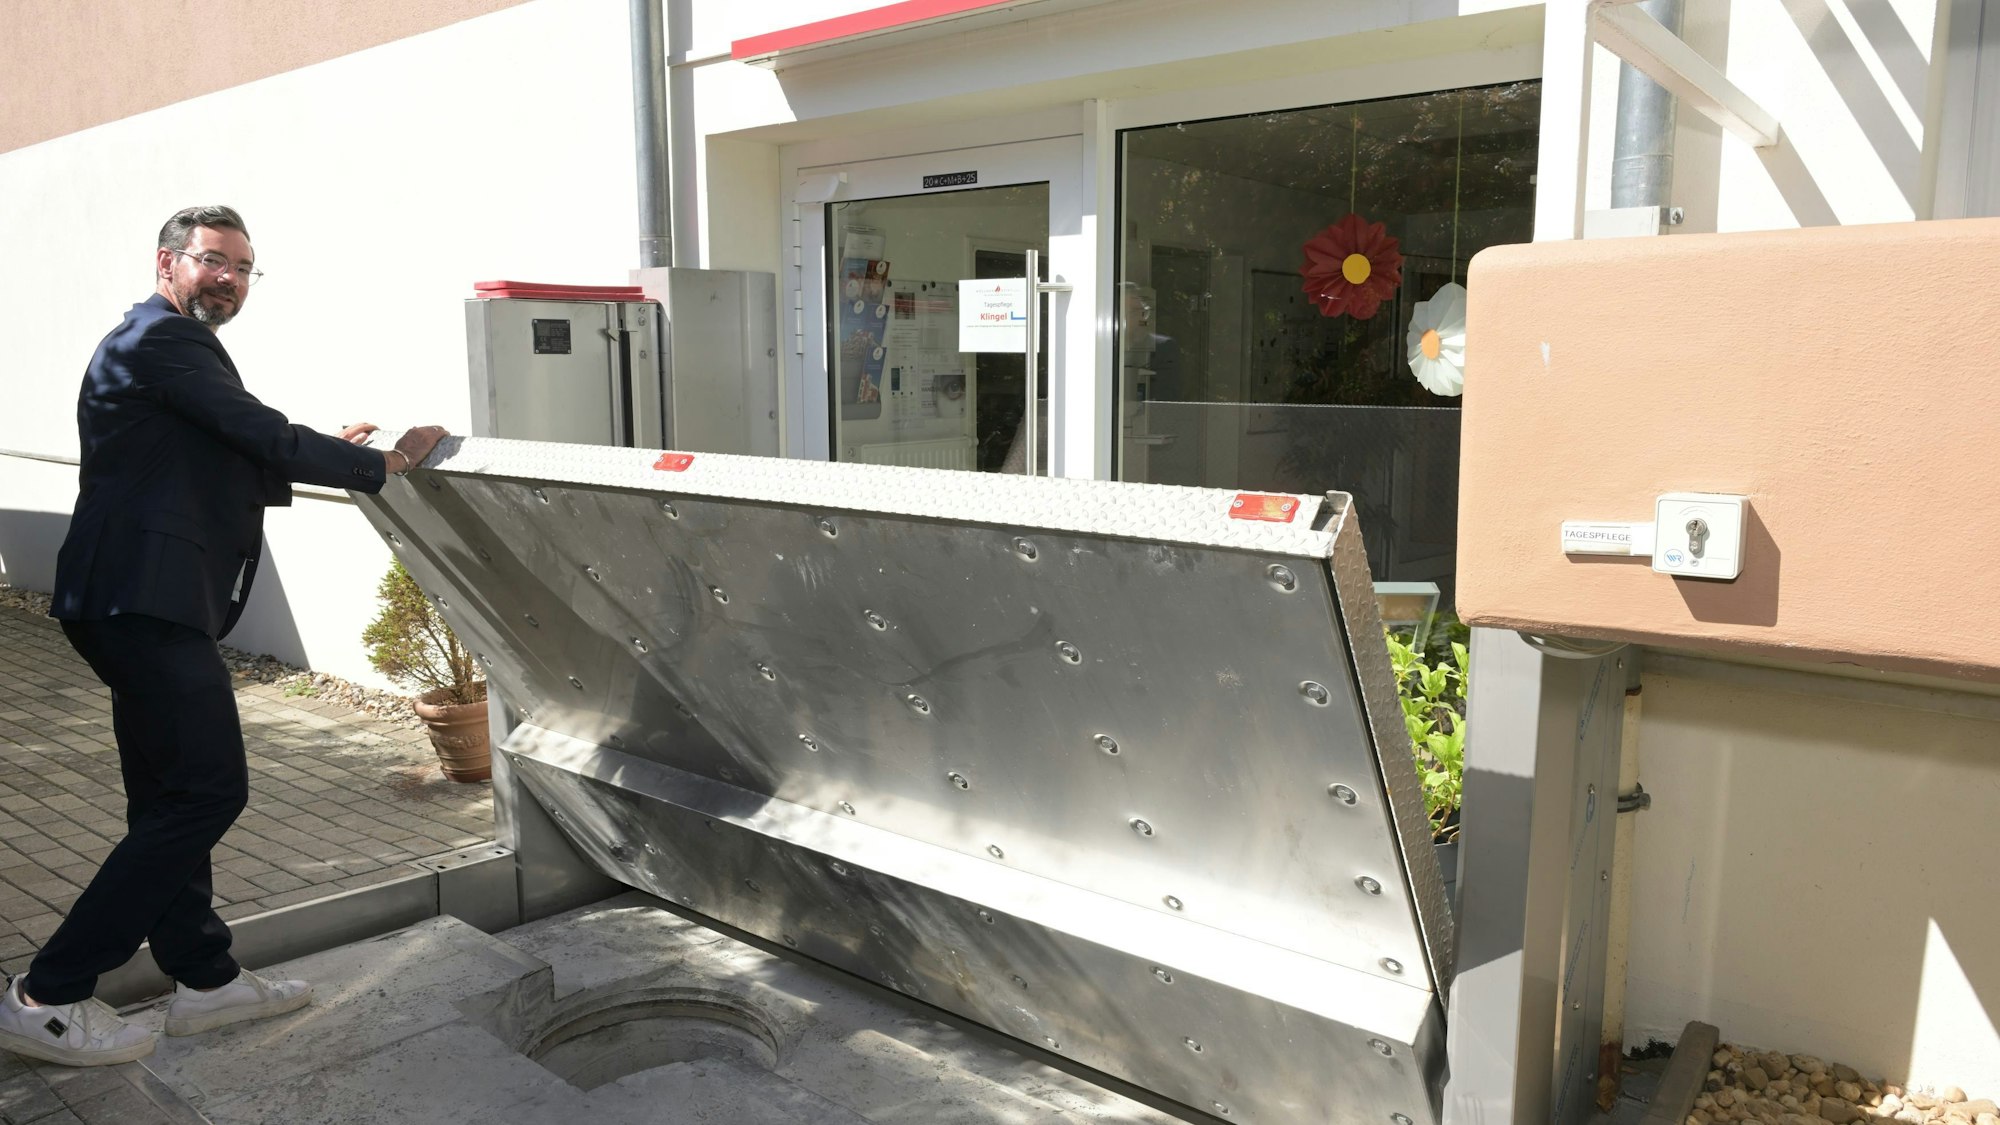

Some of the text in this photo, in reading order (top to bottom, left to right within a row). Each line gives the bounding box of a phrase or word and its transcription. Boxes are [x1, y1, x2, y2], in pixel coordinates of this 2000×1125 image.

[984, 301, 1013, 309] Tagespflege
[980, 313, 1008, 322] Klingel
[1565, 530, 1632, 542] TAGESPFLEGE
